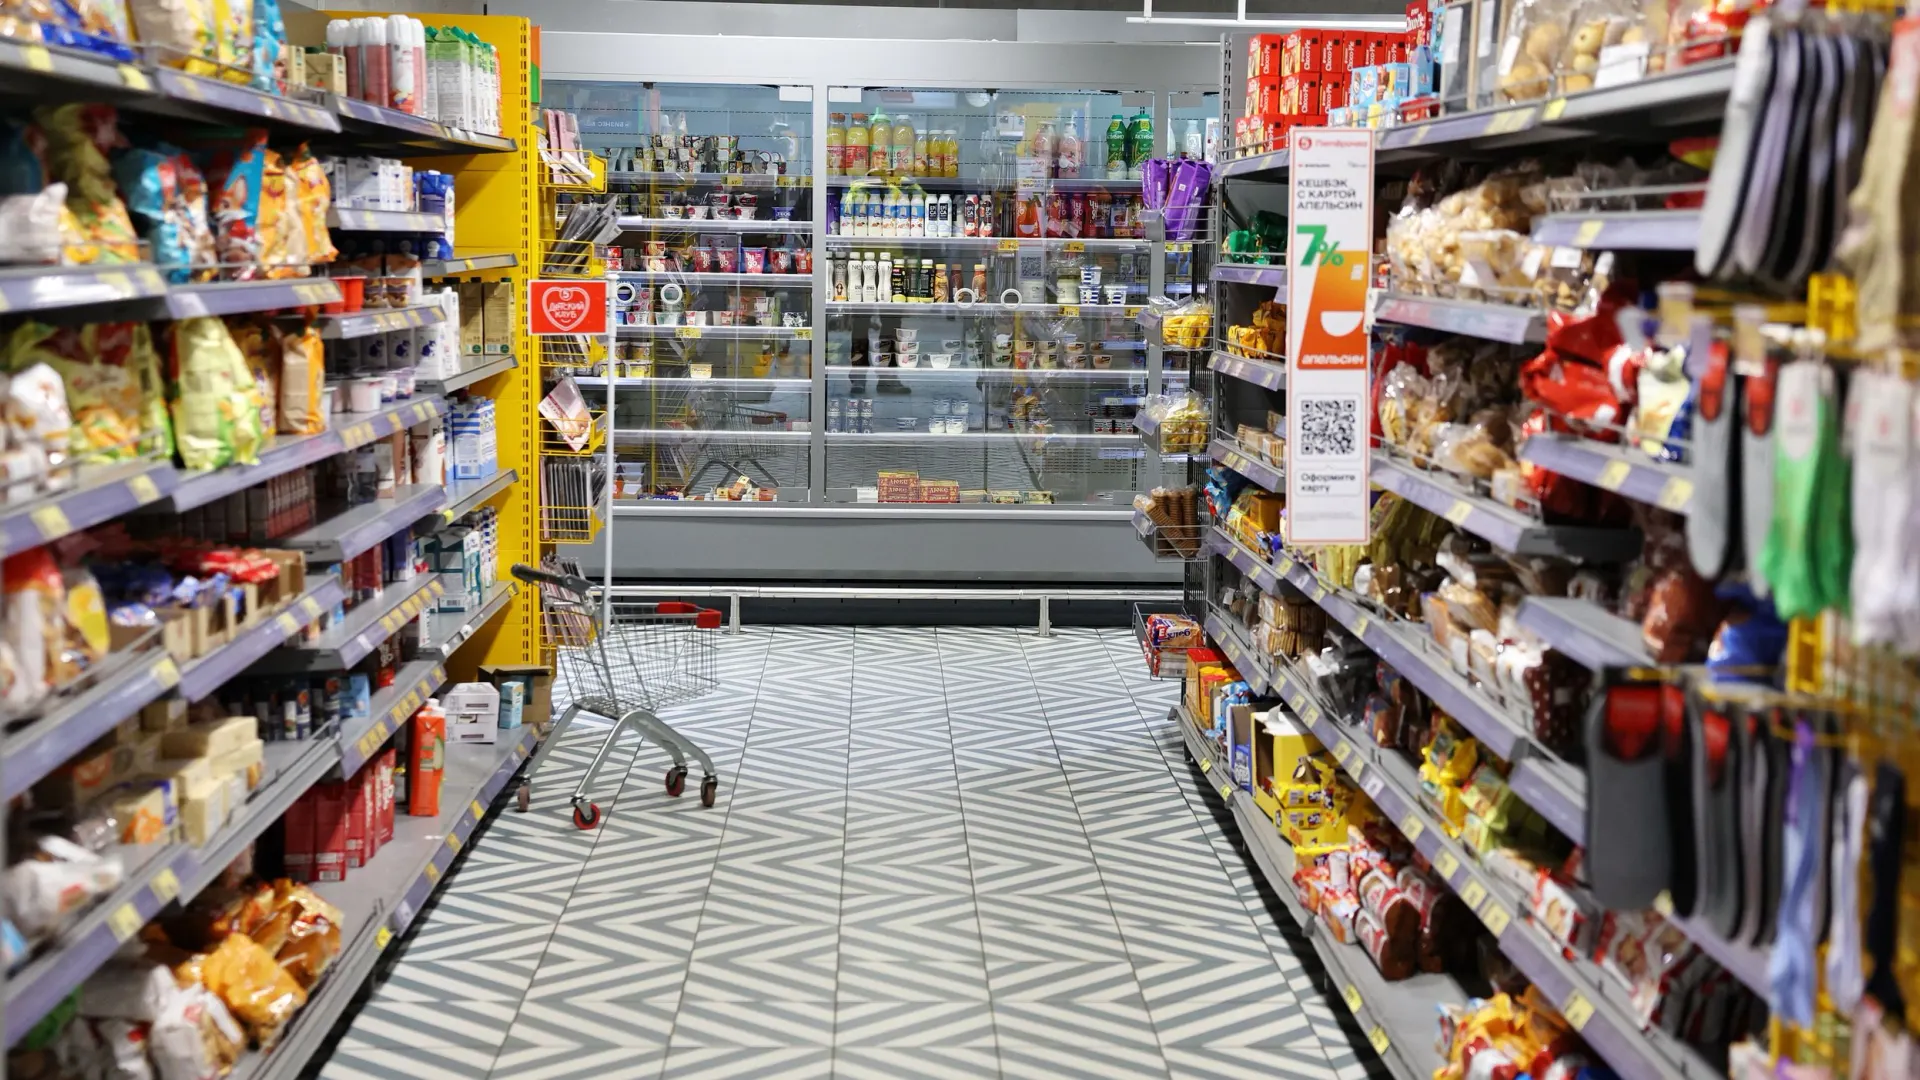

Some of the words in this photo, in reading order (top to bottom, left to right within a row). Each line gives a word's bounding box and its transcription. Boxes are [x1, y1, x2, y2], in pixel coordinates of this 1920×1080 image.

[1325, 40, 1333, 72] Choco-Pie
[1301, 82, 1309, 113] Choco-Pie
[1297, 178, 1347, 188] КЕШБЭК
[1297, 190, 1305, 199] С
[1308, 189, 1356, 199] КАРТОЙ
[1297, 201, 1362, 210] АПЕЛЬСИН
[1297, 224, 1344, 267] 7%
[549, 301, 585, 312] ДЕТСКИЙ
[555, 310, 577, 318] КЛУБ
[1301, 473, 1355, 482] Оформите
[1301, 485, 1330, 493] карту
[1167, 628, 1191, 640] хлеб
